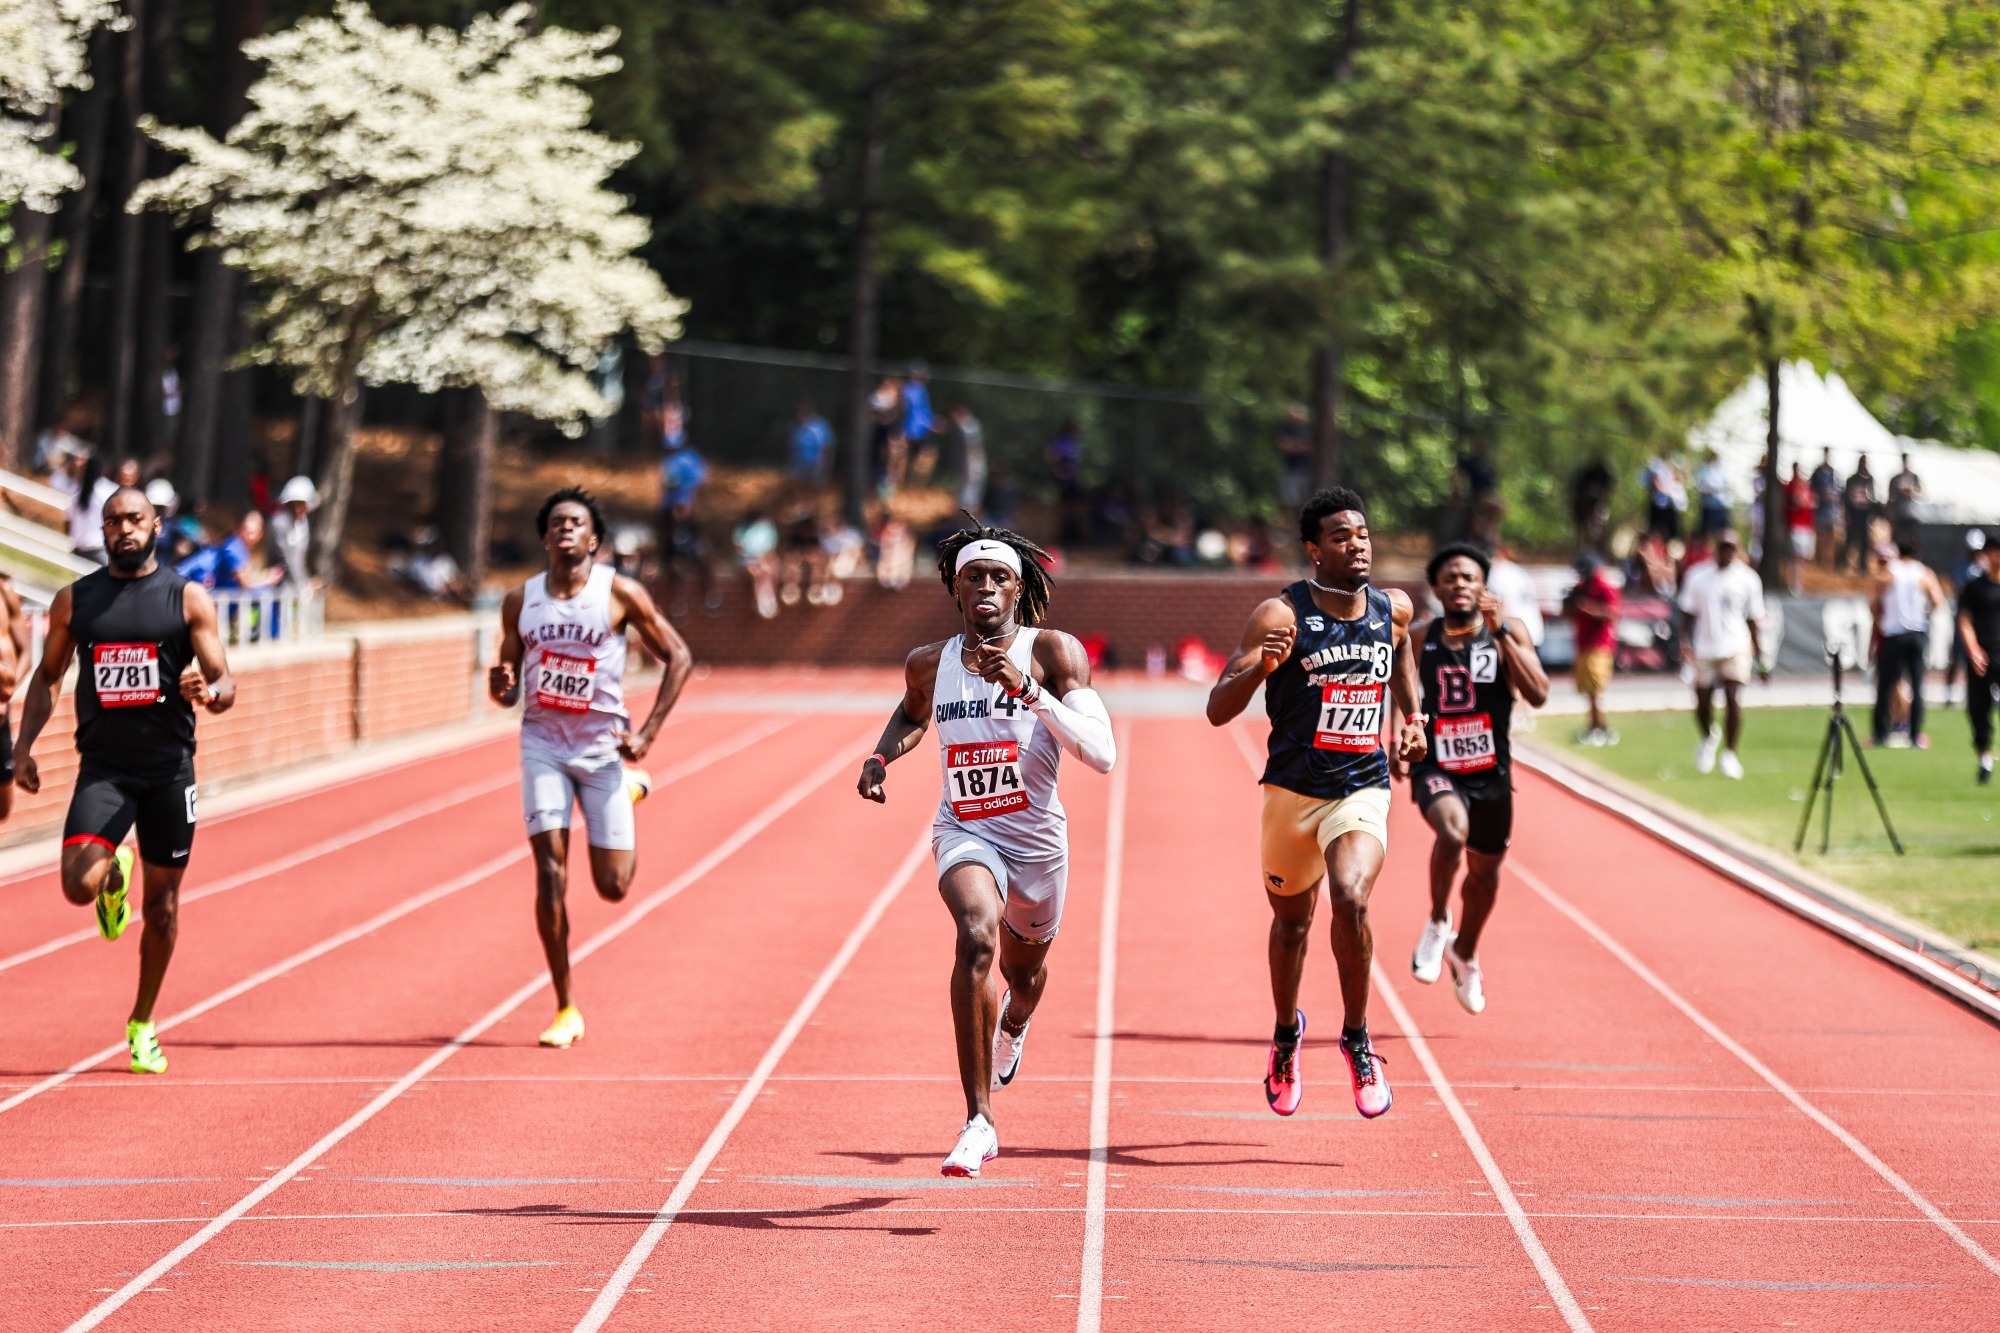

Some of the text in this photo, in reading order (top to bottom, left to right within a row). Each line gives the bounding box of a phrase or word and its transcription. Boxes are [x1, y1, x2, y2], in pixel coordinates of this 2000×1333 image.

[100, 648, 149, 663] NC STATE
[1374, 646, 1388, 679] 3
[1476, 654, 1491, 680] 2
[98, 665, 151, 689] 2781
[541, 670, 590, 698] 2462
[1437, 665, 1477, 713] B
[121, 691, 156, 702] adidas
[994, 684, 1018, 717] 4
[1330, 690, 1378, 704] NC STATE
[1326, 707, 1378, 732] 1747
[1343, 737, 1376, 747] adidas
[1442, 734, 1490, 758] 1653
[954, 748, 1010, 766] NC STATE
[953, 765, 1019, 798] 1874
[983, 795, 1023, 810] adidas
